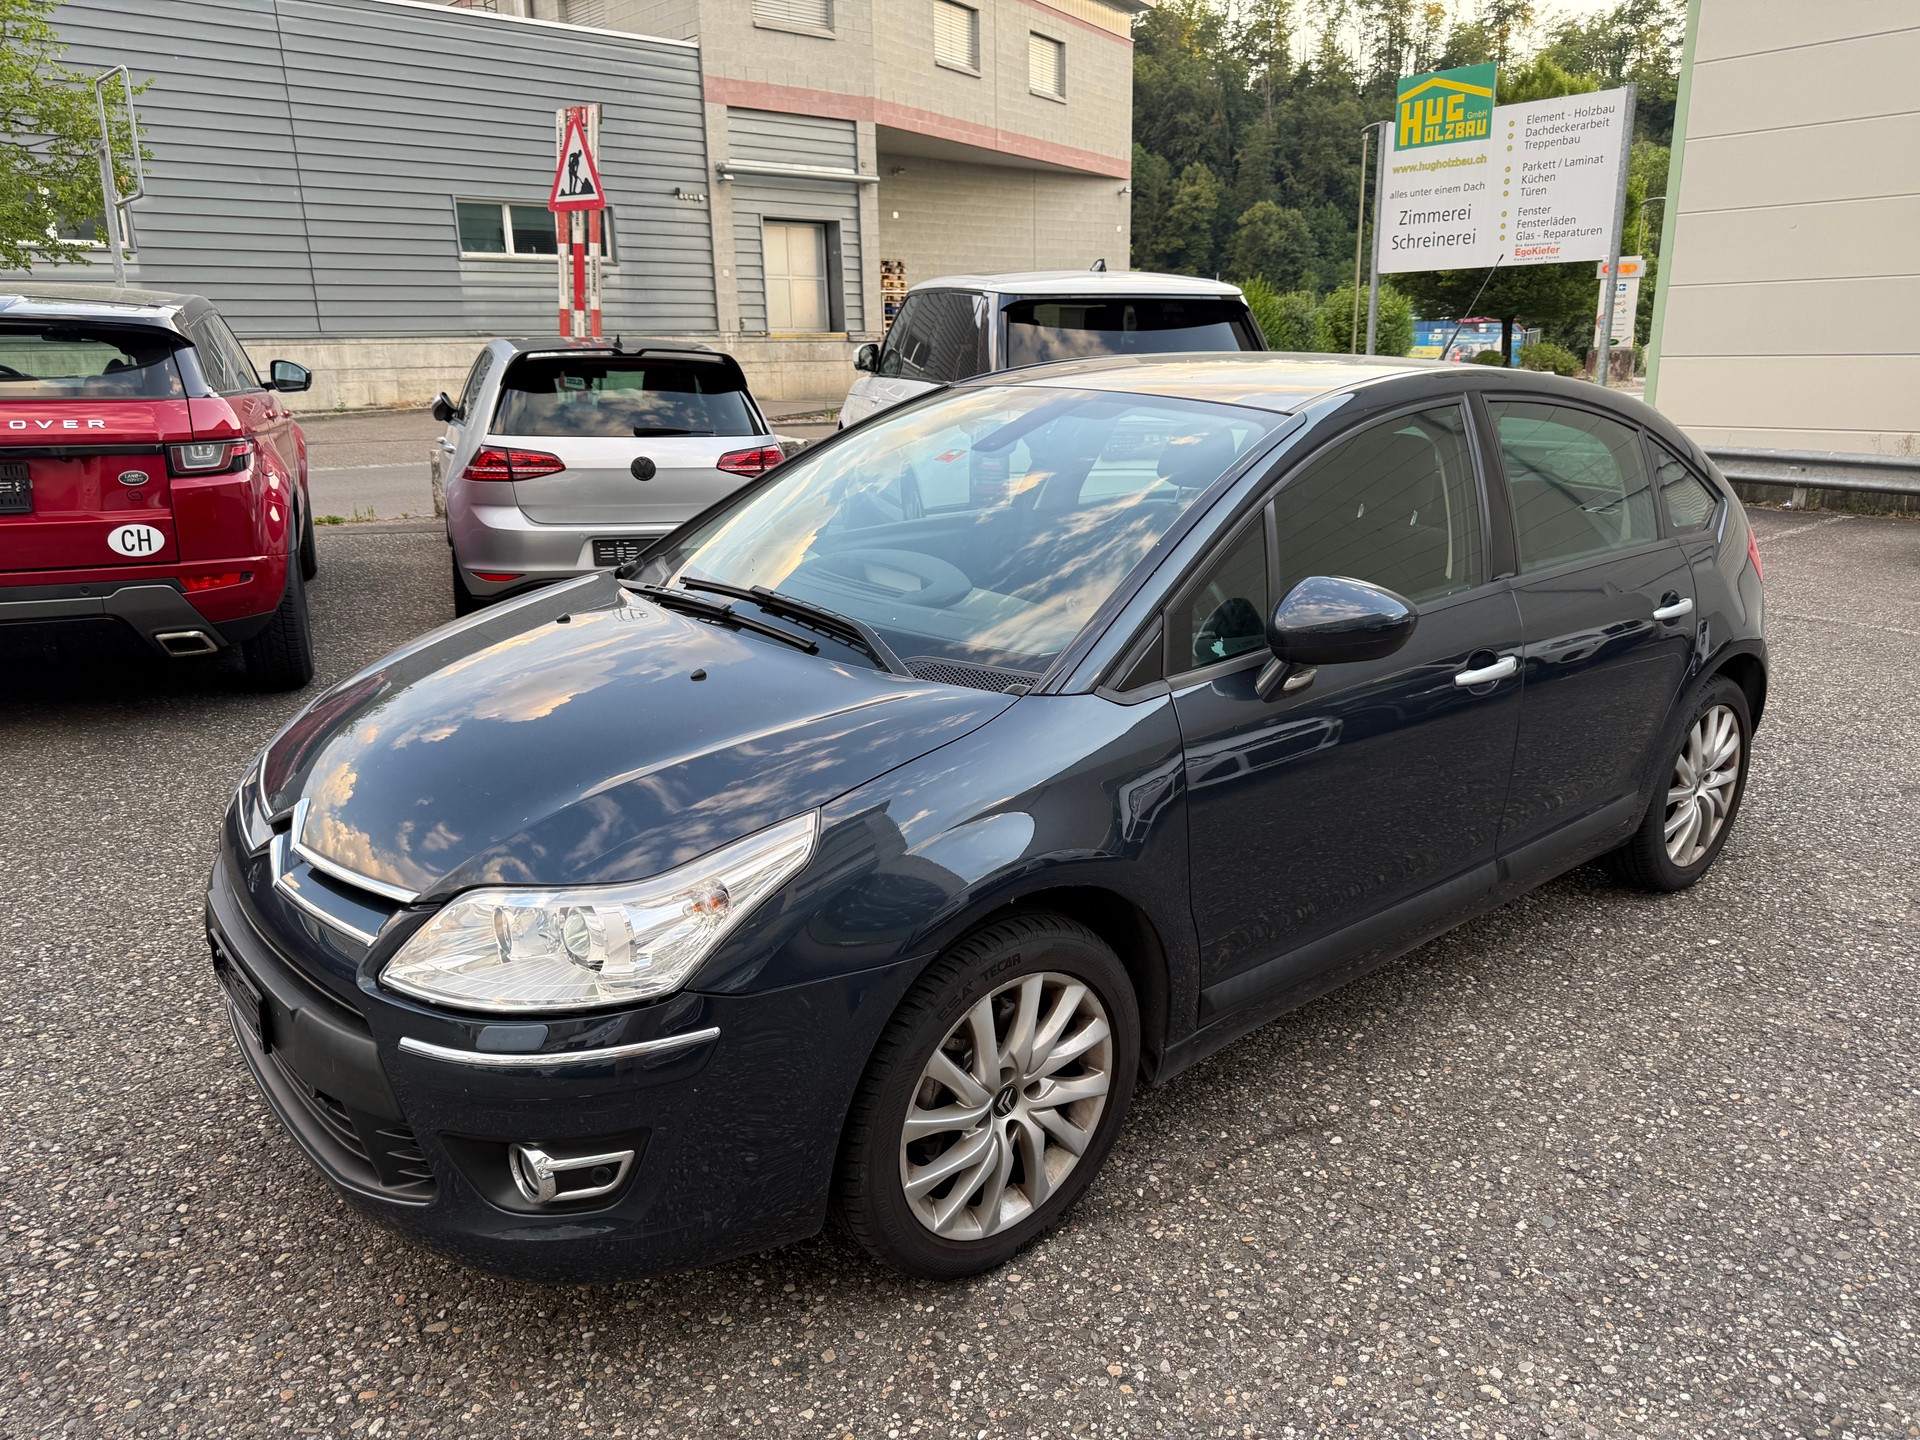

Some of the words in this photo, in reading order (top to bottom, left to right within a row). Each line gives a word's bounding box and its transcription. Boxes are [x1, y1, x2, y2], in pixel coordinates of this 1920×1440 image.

[1399, 94, 1465, 146] HUG
[1467, 110, 1488, 119] GmbH
[1526, 112, 1565, 125] Element
[1574, 105, 1615, 118] Holzbau
[1525, 117, 1610, 138] Dachdeckerarbeit
[1524, 135, 1581, 151] Treppenbau
[1392, 154, 1487, 174] www.hugholzbau.ch
[1522, 160, 1556, 172] Parkett
[1564, 154, 1605, 167] Laminat
[1521, 173, 1556, 184] Küchen
[1389, 190, 1408, 200] alles
[1409, 187, 1433, 198] unter
[1434, 184, 1461, 195] einem
[1463, 181, 1486, 192] Dach
[1520, 186, 1547, 197] Türen
[1398, 203, 1472, 226] Zimmerei
[1518, 206, 1552, 216] Fenster
[1516, 215, 1577, 228] Fensterläden
[1391, 228, 1477, 250] Schreinerei
[1515, 231, 1535, 241] Glas
[1543, 226, 1603, 240] Reparaturen
[1514, 246, 1561, 258] EgoKiefer
[8, 419, 106, 430] OVER
[121, 529, 153, 552] CH
[980, 952, 1021, 981] TECAR
